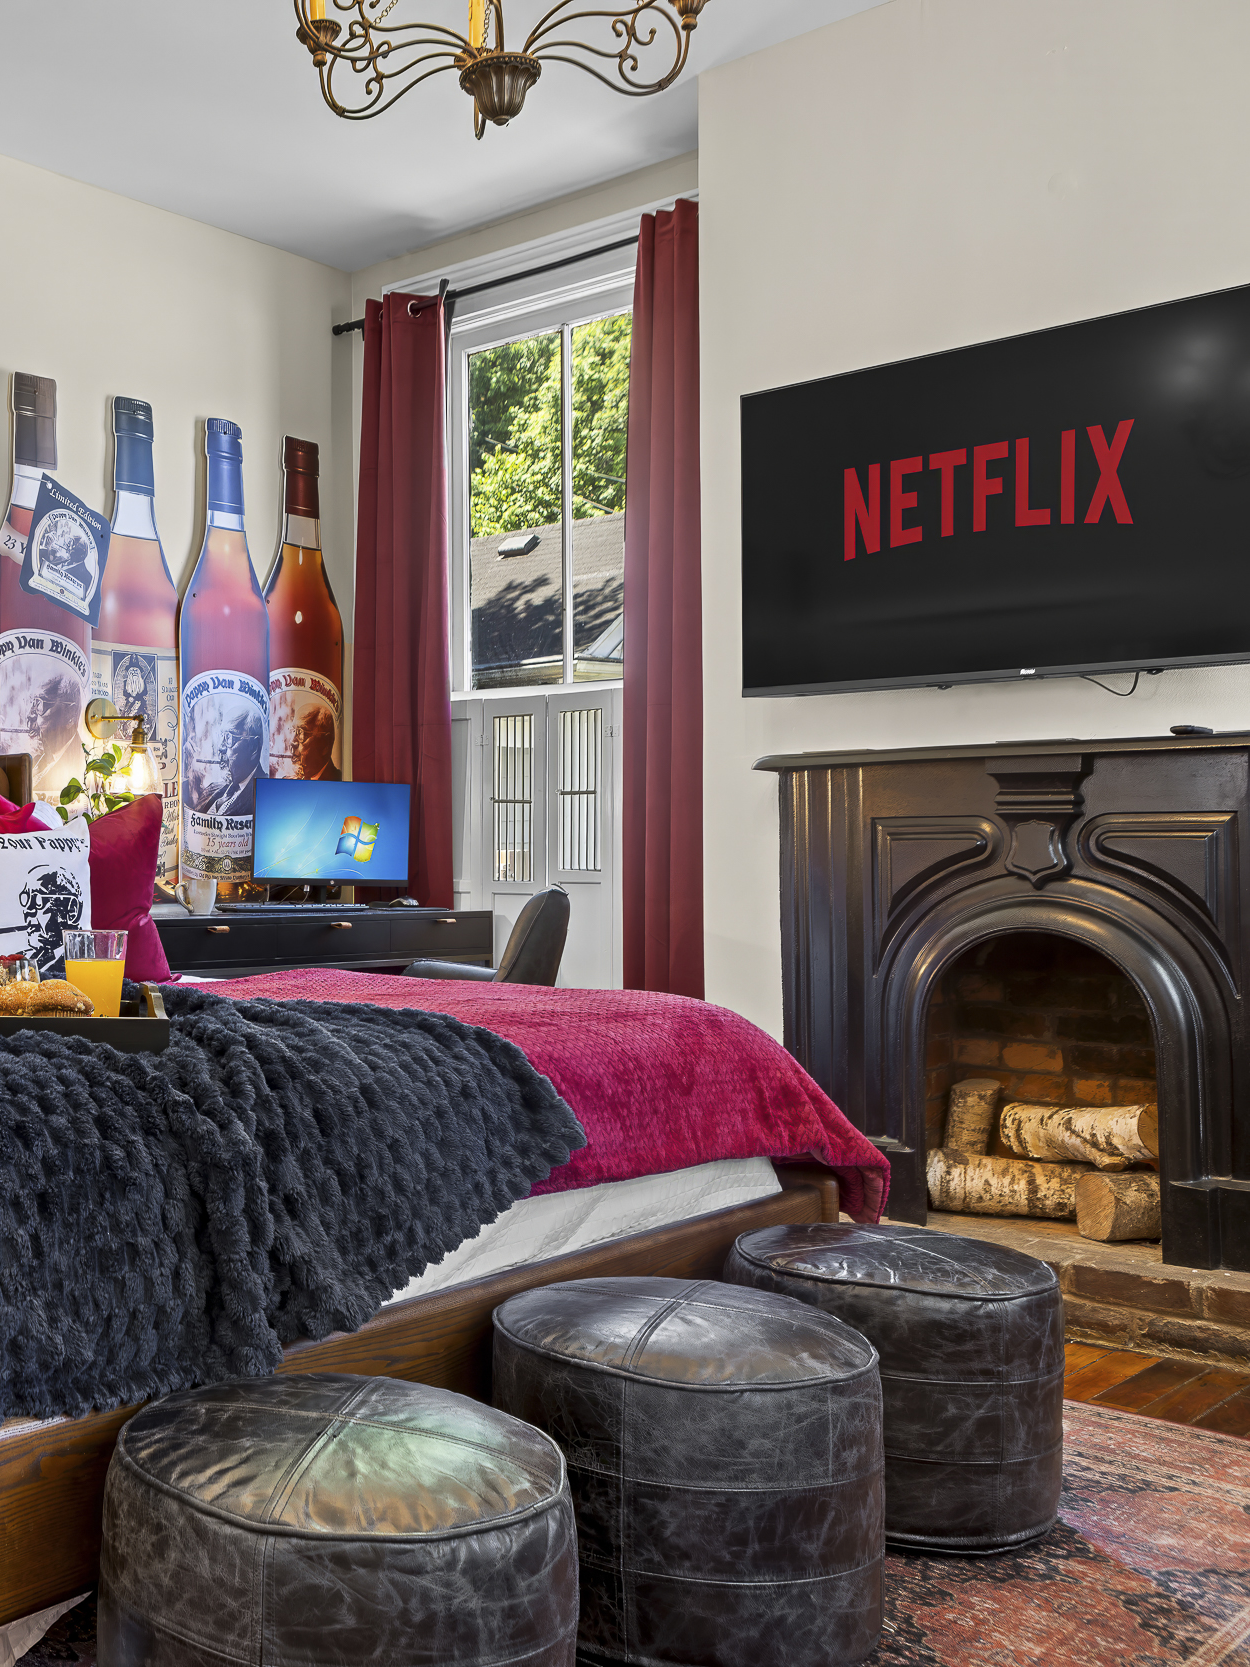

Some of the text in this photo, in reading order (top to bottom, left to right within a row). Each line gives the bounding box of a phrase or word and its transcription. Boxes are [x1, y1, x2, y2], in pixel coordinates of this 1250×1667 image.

[843, 418, 1135, 562] NETFLIX
[49, 488, 102, 531] Limited Edition
[3, 534, 17, 550] 23
[15, 635, 45, 650] Van
[49, 638, 87, 678] Winkle's
[185, 681, 210, 708] Pappy
[210, 676, 235, 690] Van
[282, 673, 306, 688] Van
[190, 812, 224, 833] Family
[225, 817, 253, 831] Reser
[206, 836, 250, 850] 15 years old
